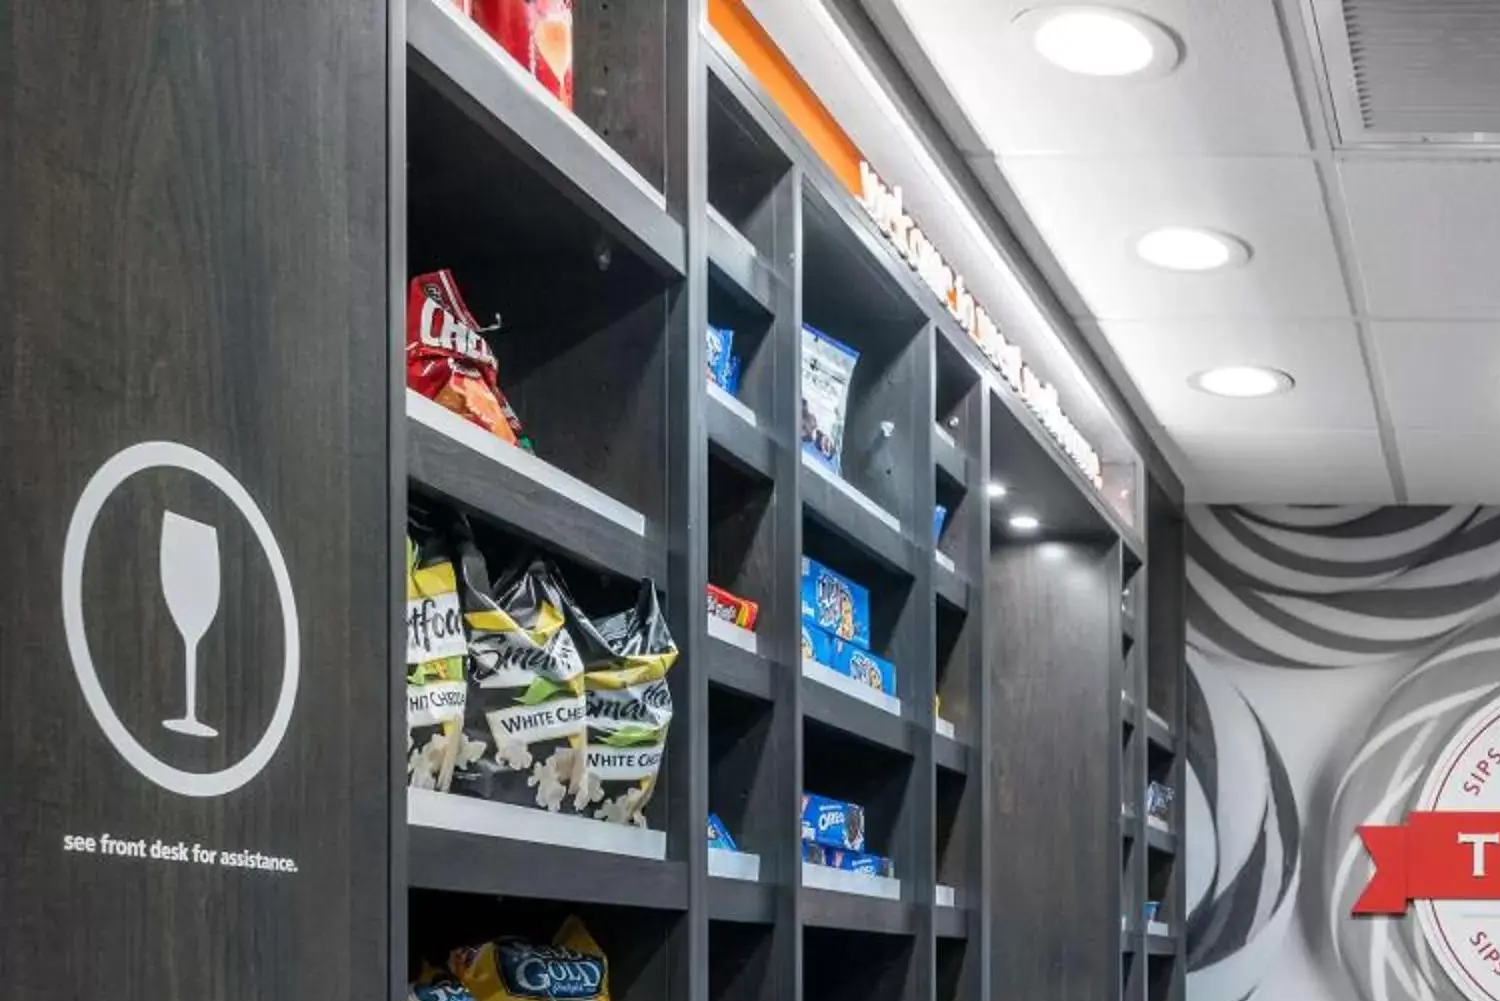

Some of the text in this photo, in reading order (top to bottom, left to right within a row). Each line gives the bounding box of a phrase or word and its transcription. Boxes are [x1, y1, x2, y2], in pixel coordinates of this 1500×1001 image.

[501, 711, 553, 734] WHITE
[63, 833, 298, 873] see front desk for assistance.
[516, 957, 600, 991] GOLD
